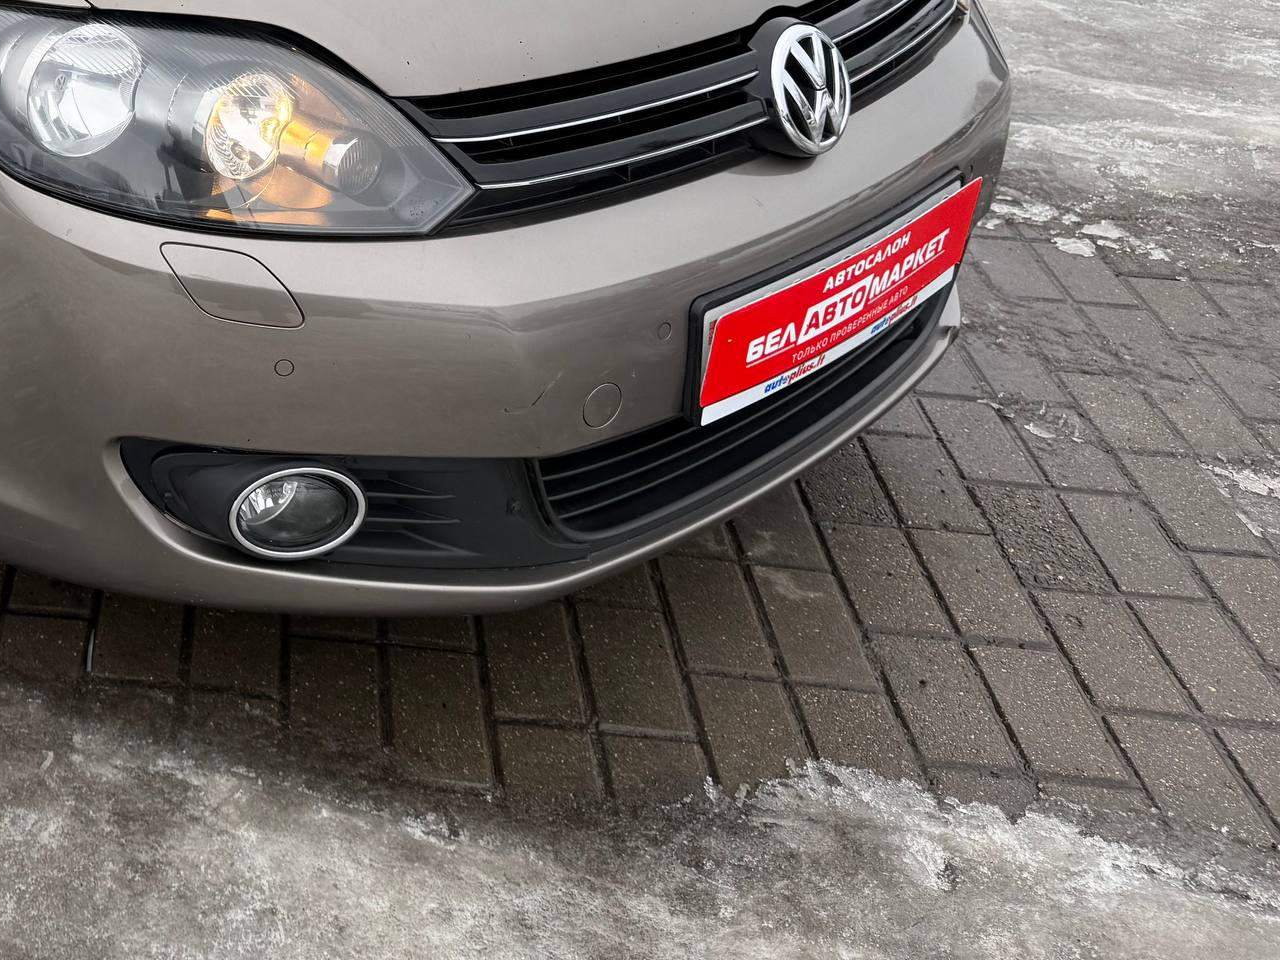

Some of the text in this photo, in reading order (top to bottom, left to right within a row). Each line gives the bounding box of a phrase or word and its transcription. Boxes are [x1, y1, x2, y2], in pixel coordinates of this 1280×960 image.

[822, 231, 912, 294] АВТОСАЛОН
[792, 285, 909, 364] ТОЛЬКО ПРОВЕРЕННЫЕ АВТО
